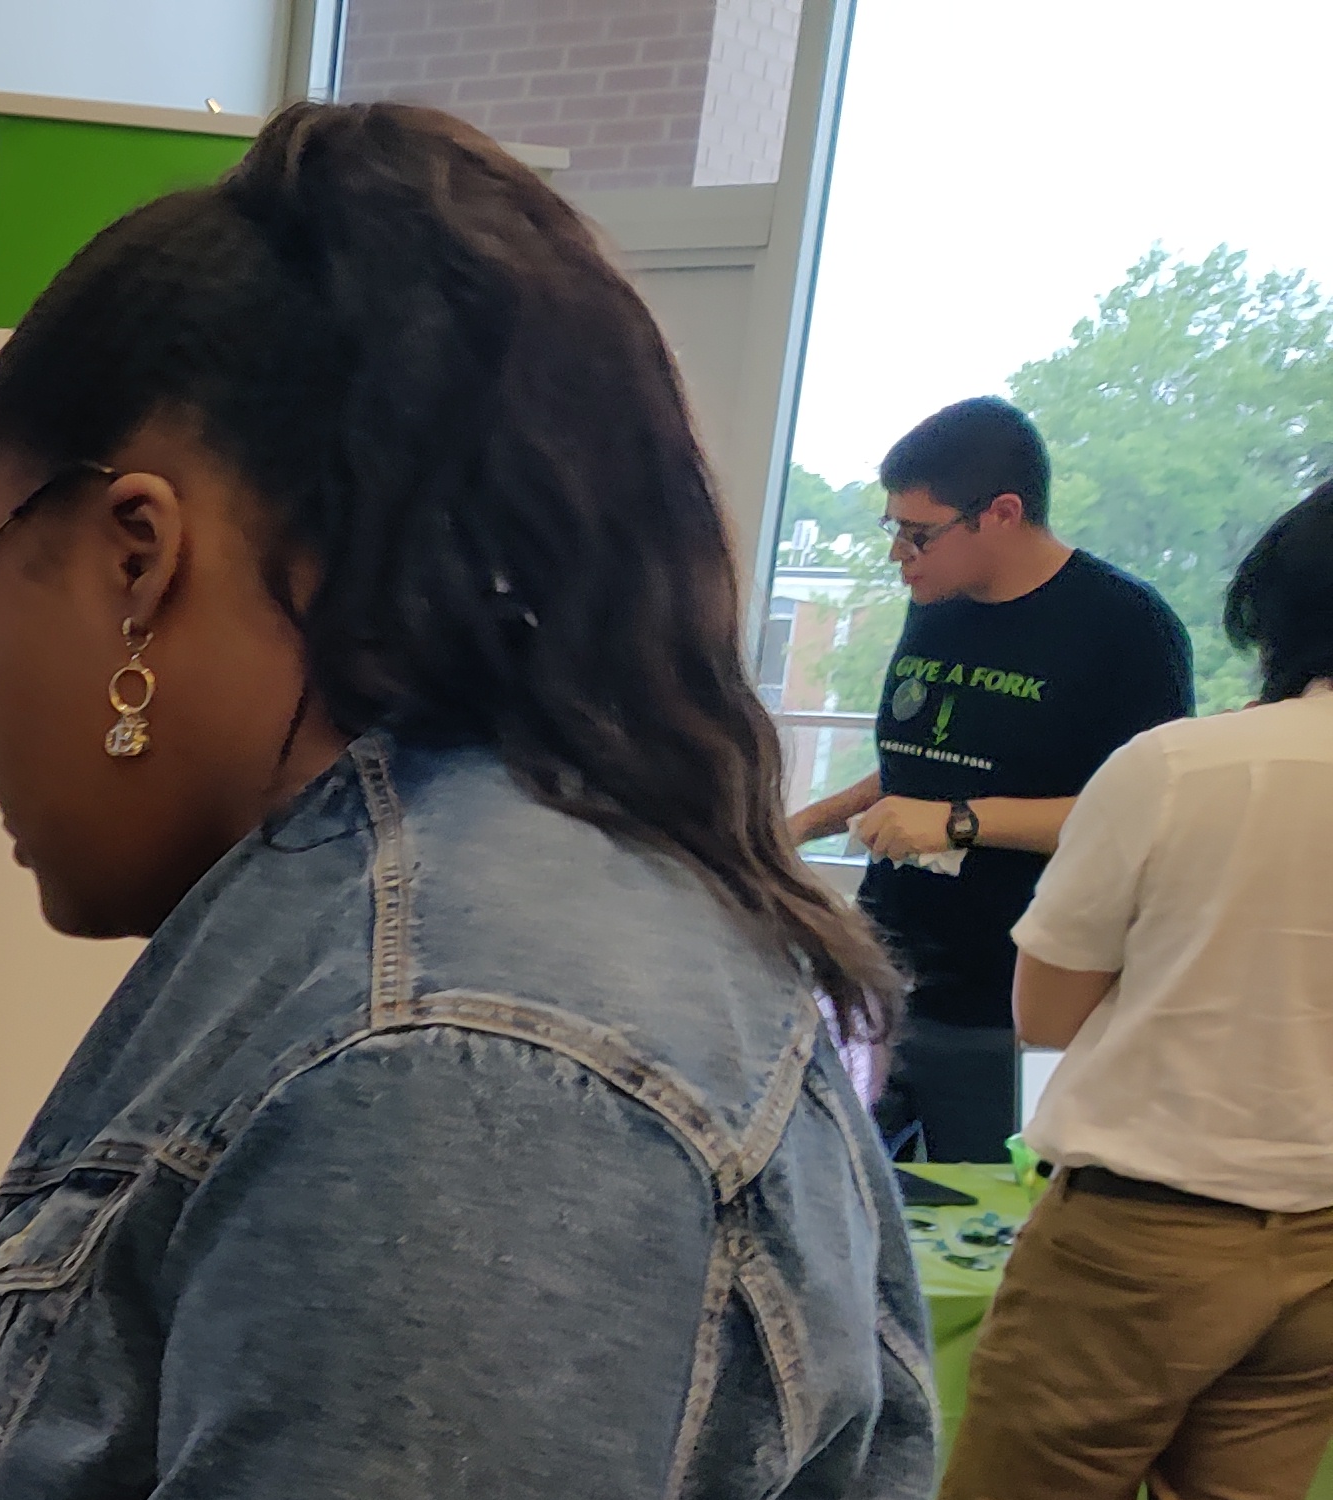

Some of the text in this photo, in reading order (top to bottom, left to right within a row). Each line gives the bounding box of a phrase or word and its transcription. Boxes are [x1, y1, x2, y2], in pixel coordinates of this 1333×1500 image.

[896, 655, 1045, 701] GIVE A FORK
